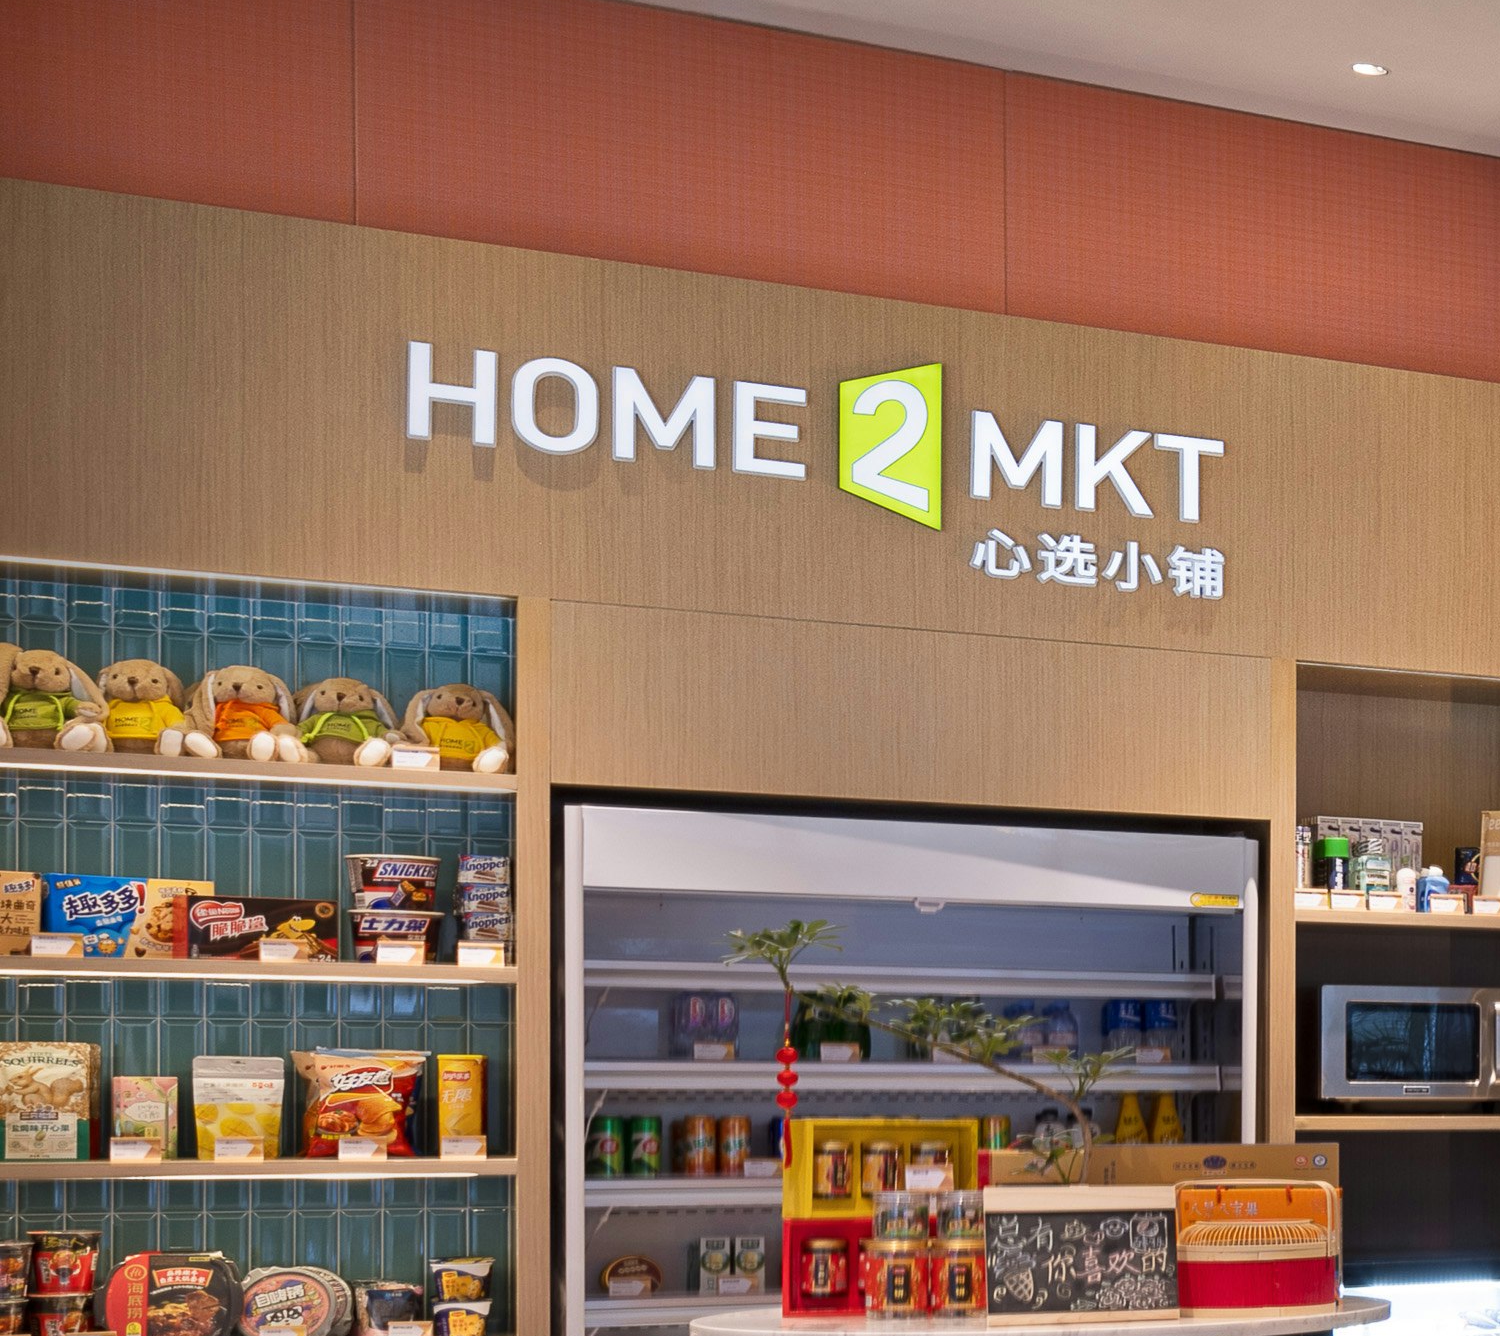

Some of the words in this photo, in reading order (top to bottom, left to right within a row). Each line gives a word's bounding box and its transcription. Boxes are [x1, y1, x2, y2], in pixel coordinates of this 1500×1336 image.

[406, 340, 808, 481] HOME
[852, 379, 930, 513] 2
[969, 409, 1225, 524] MKT
[969, 528, 1226, 601] 心选小铺
[361, 918, 428, 932] 士力架
[3, 1055, 85, 1067] SQUIRRELS
